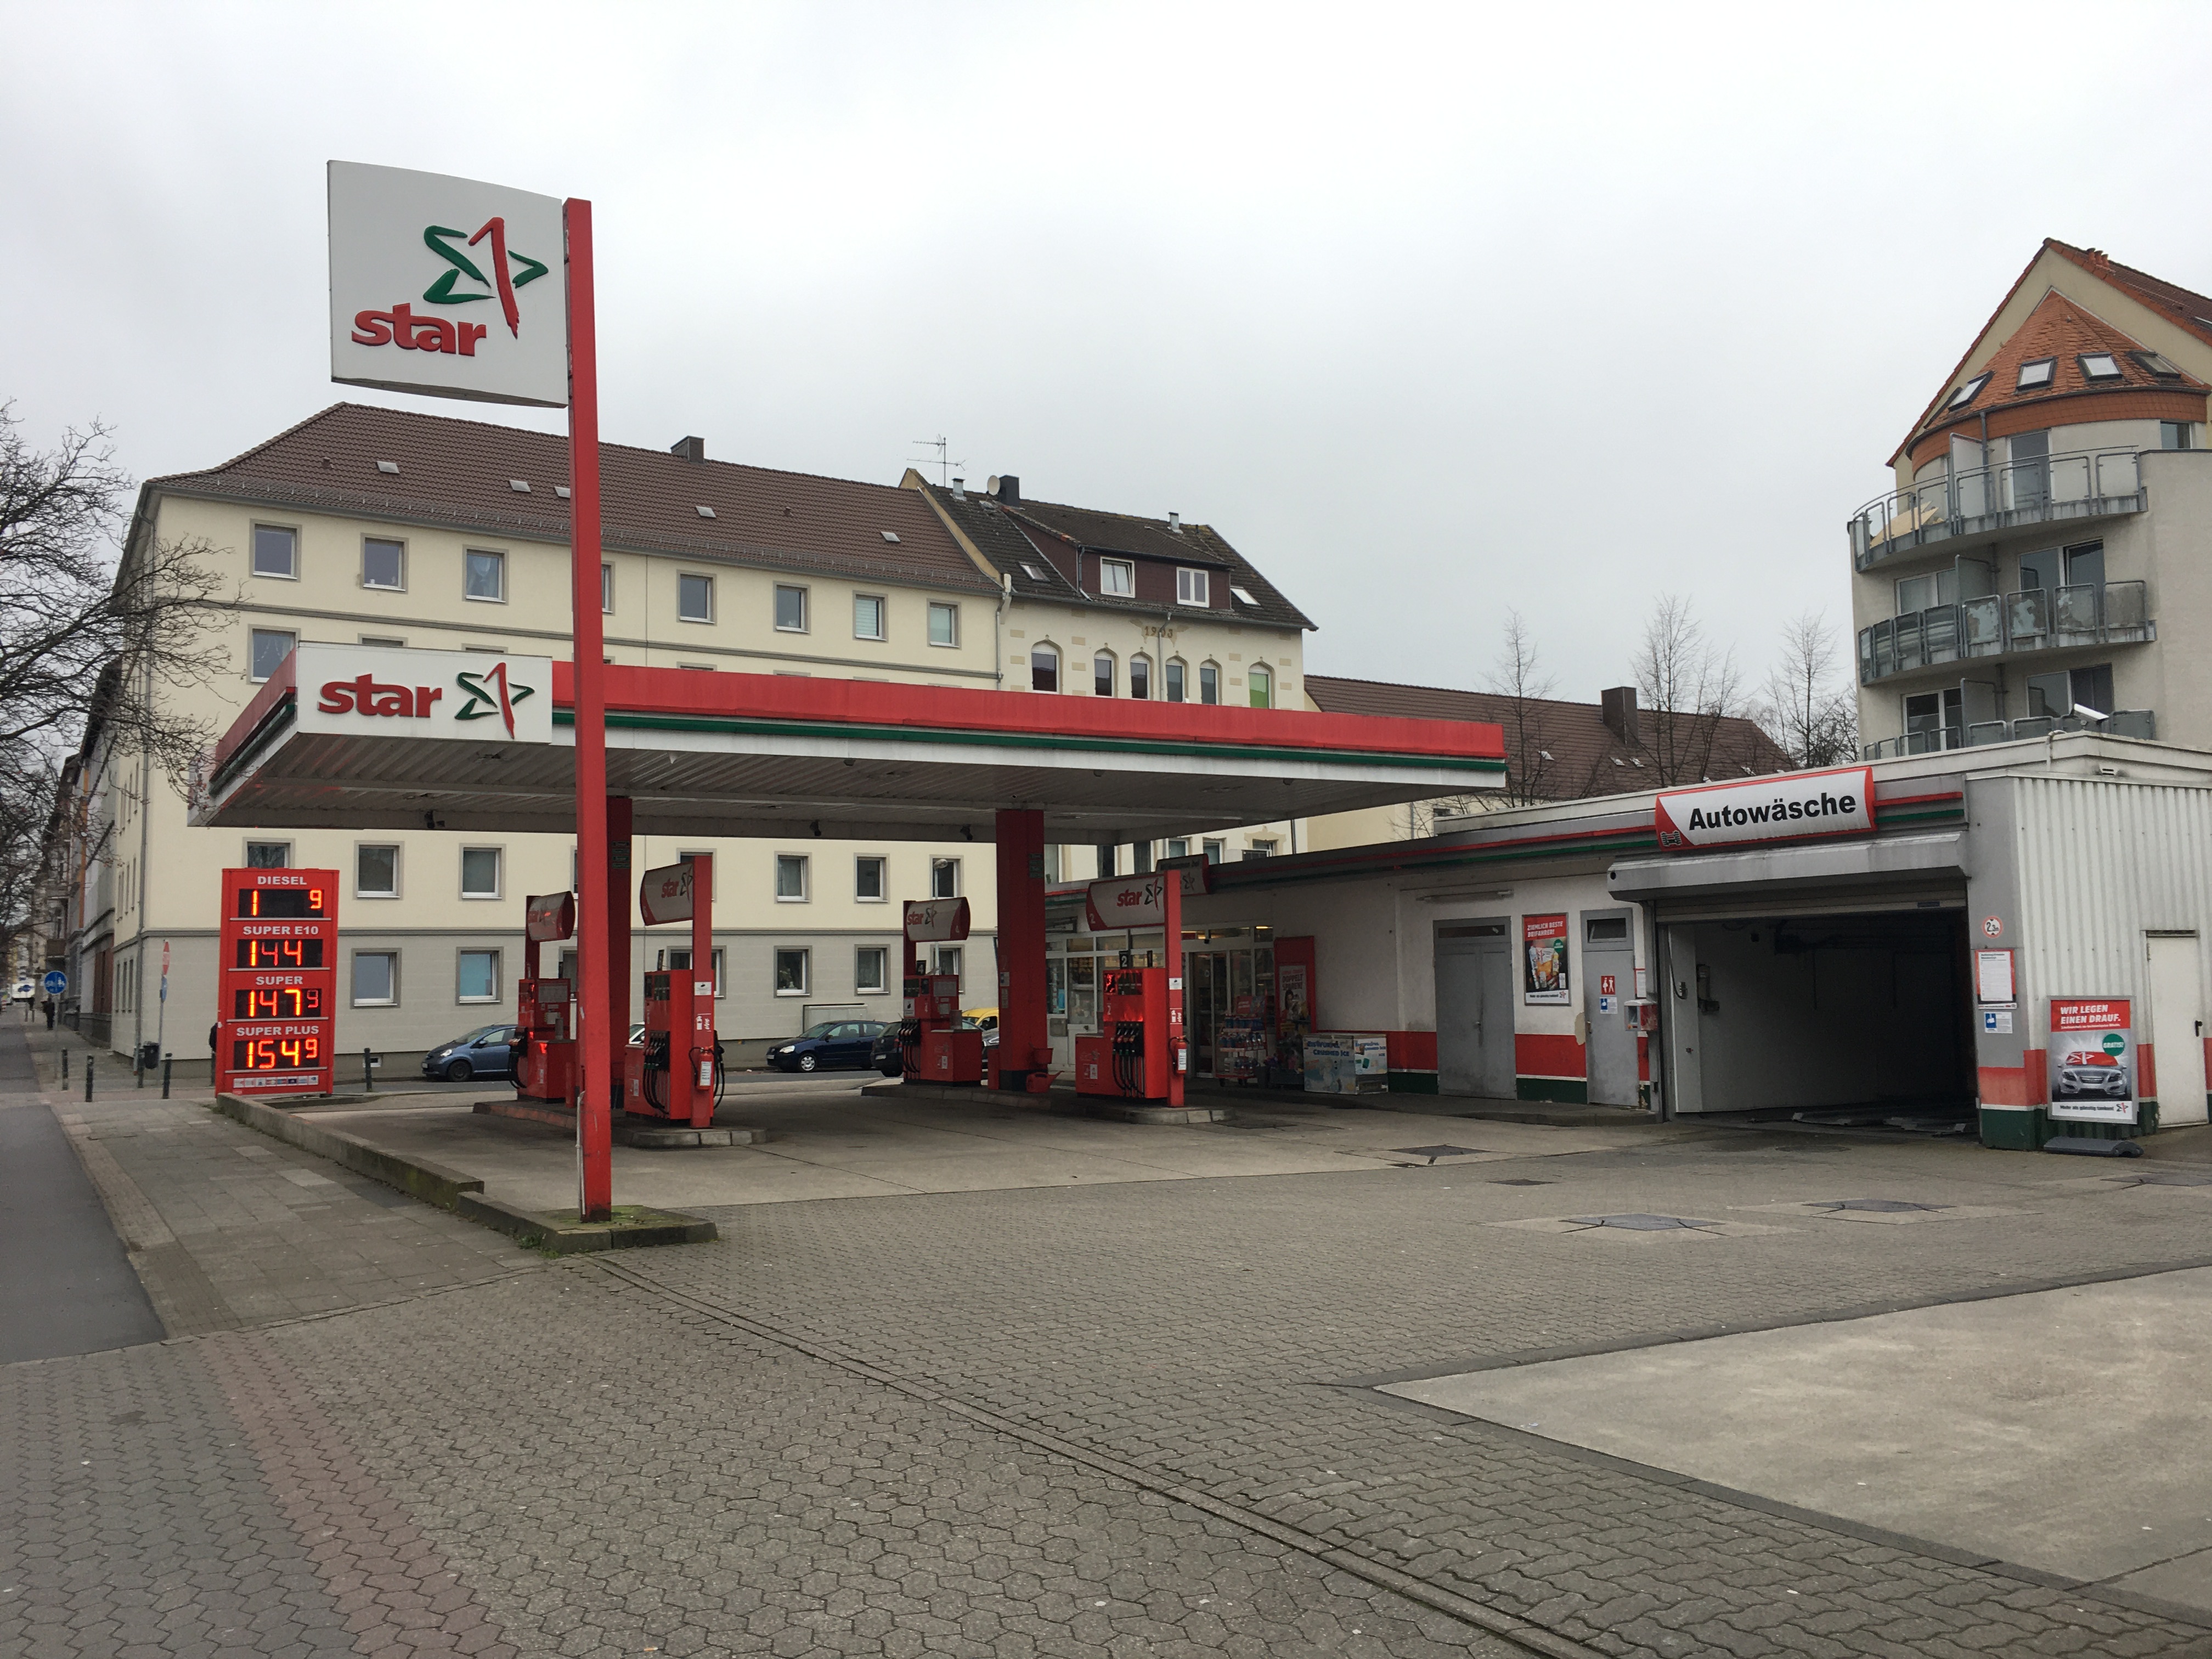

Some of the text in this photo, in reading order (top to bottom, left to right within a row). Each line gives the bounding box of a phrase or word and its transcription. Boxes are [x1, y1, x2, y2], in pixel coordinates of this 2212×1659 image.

[352, 303, 487, 357] star
[317, 674, 442, 718] star
[1689, 793, 1857, 831] Autowäsche
[257, 876, 307, 885] DIESEL
[661, 878, 680, 898] star
[1116, 888, 1143, 907] star
[907, 911, 924, 925] star
[1090, 913, 1096, 924] 2
[243, 926, 319, 935] SUPER E10
[1121, 956, 1127, 967] 2
[256, 977, 303, 985] SUPER
[2060, 1005, 2108, 1015] WIR LEGEN
[2061, 1014, 2121, 1024] EINEN DRAUF.
[236, 1025, 319, 1036] SUPER PLUS
